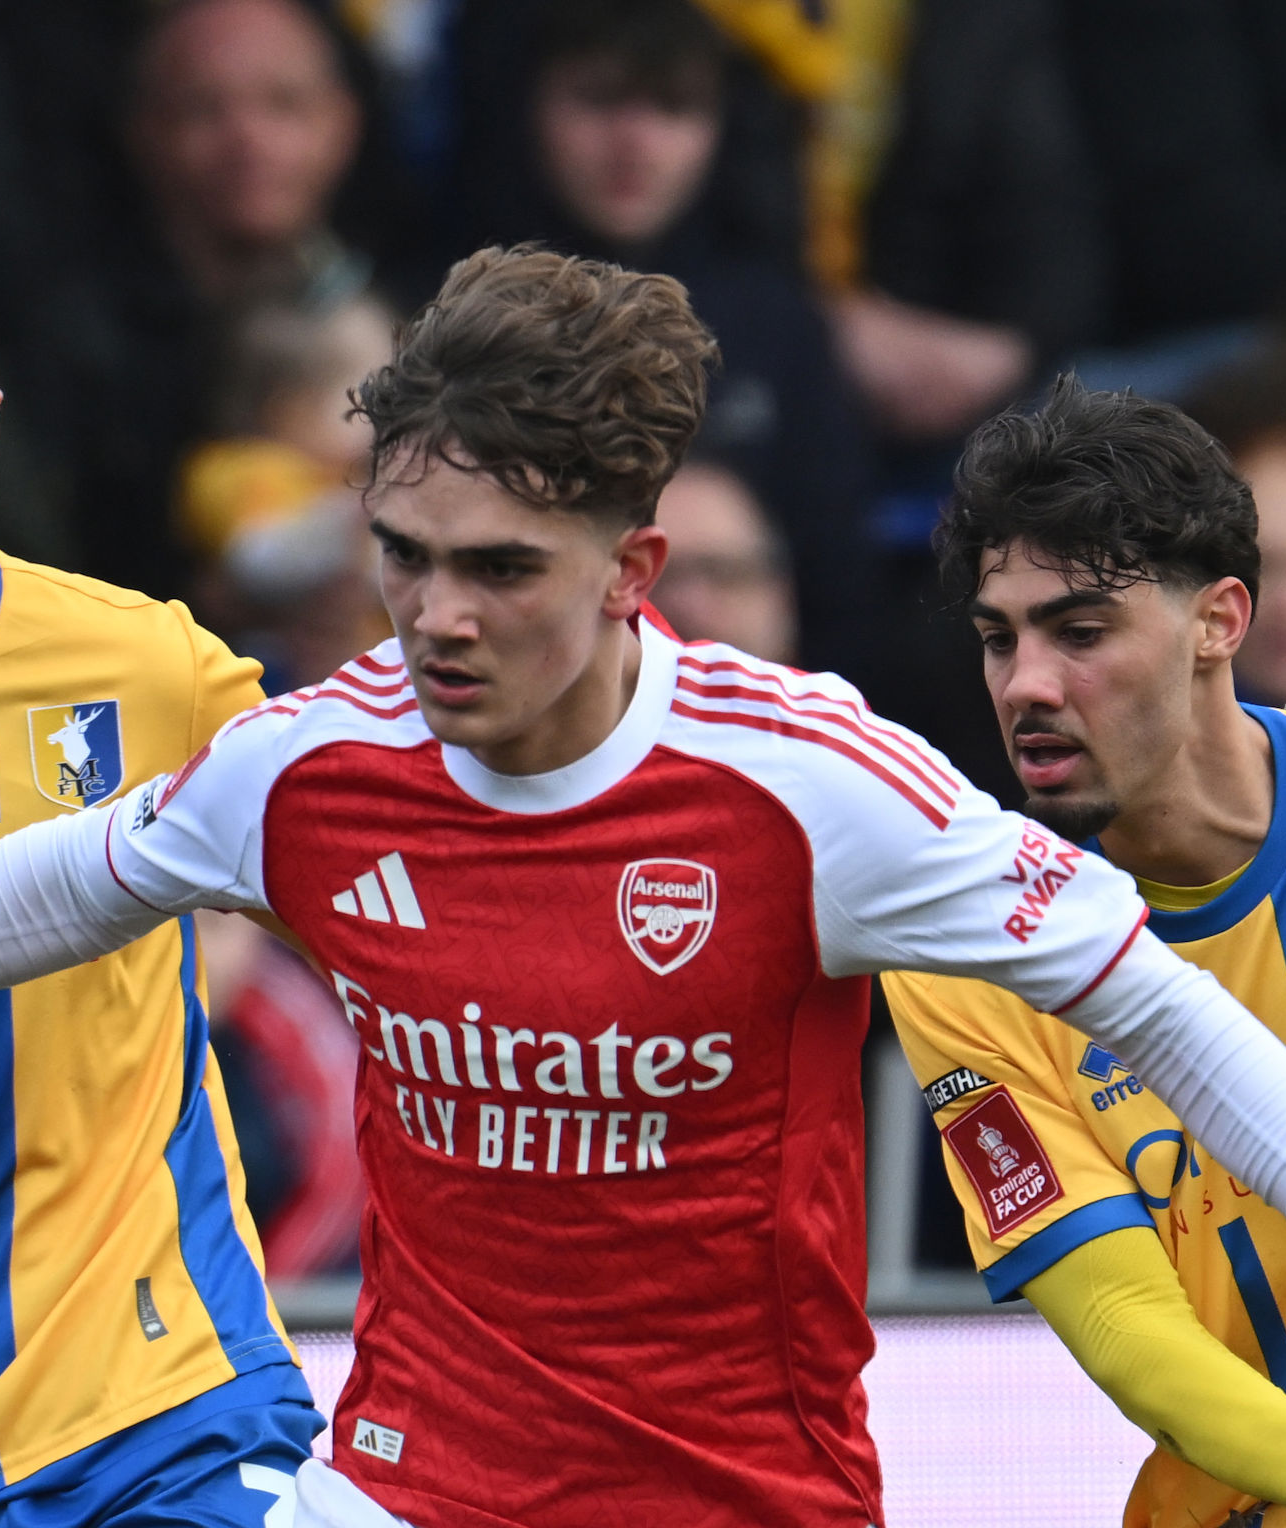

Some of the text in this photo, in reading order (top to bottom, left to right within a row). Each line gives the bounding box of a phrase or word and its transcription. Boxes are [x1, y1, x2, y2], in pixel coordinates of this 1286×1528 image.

[632, 876, 704, 900] Arsenal
[1003, 838, 1084, 944] RWAN
[331, 970, 734, 1099] Emirates
[1091, 1073, 1144, 1112] erre
[396, 1083, 669, 1175] FLY BETTER
[989, 1161, 1041, 1204] Emirates
[995, 1174, 1047, 1221] FA CUP
